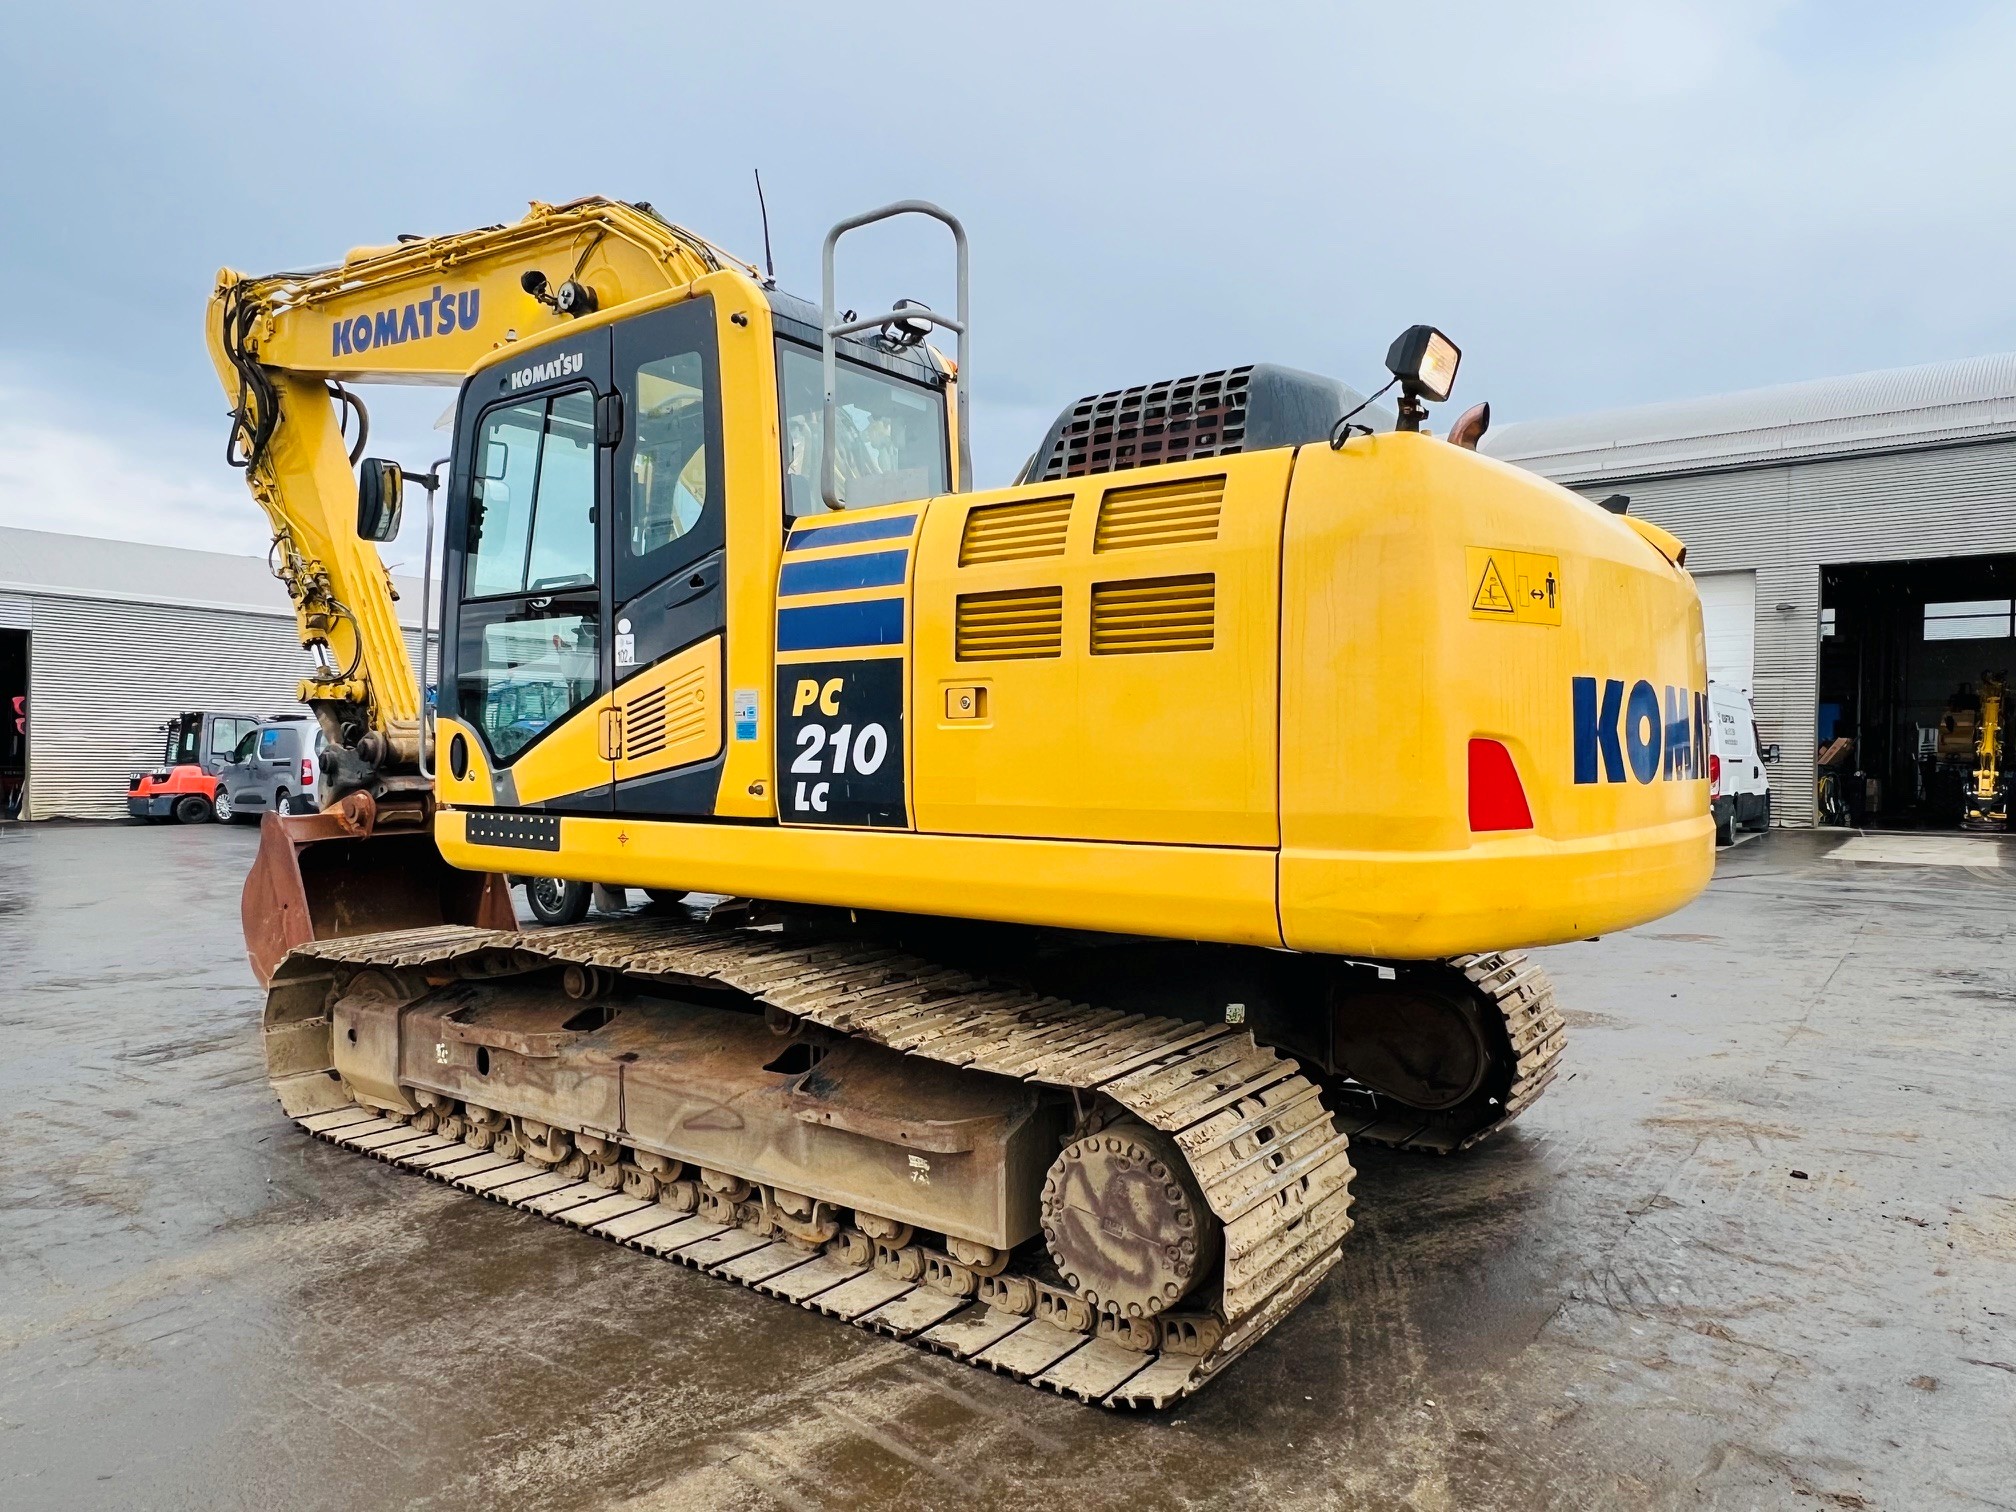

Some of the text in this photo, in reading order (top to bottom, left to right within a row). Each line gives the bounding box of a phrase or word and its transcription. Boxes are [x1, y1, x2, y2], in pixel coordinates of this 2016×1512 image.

[332, 286, 480, 357] KOMATSU
[511, 353, 583, 390] KOMATSU
[792, 678, 844, 717] PC
[790, 722, 888, 776] 210
[794, 781, 830, 812] LC
